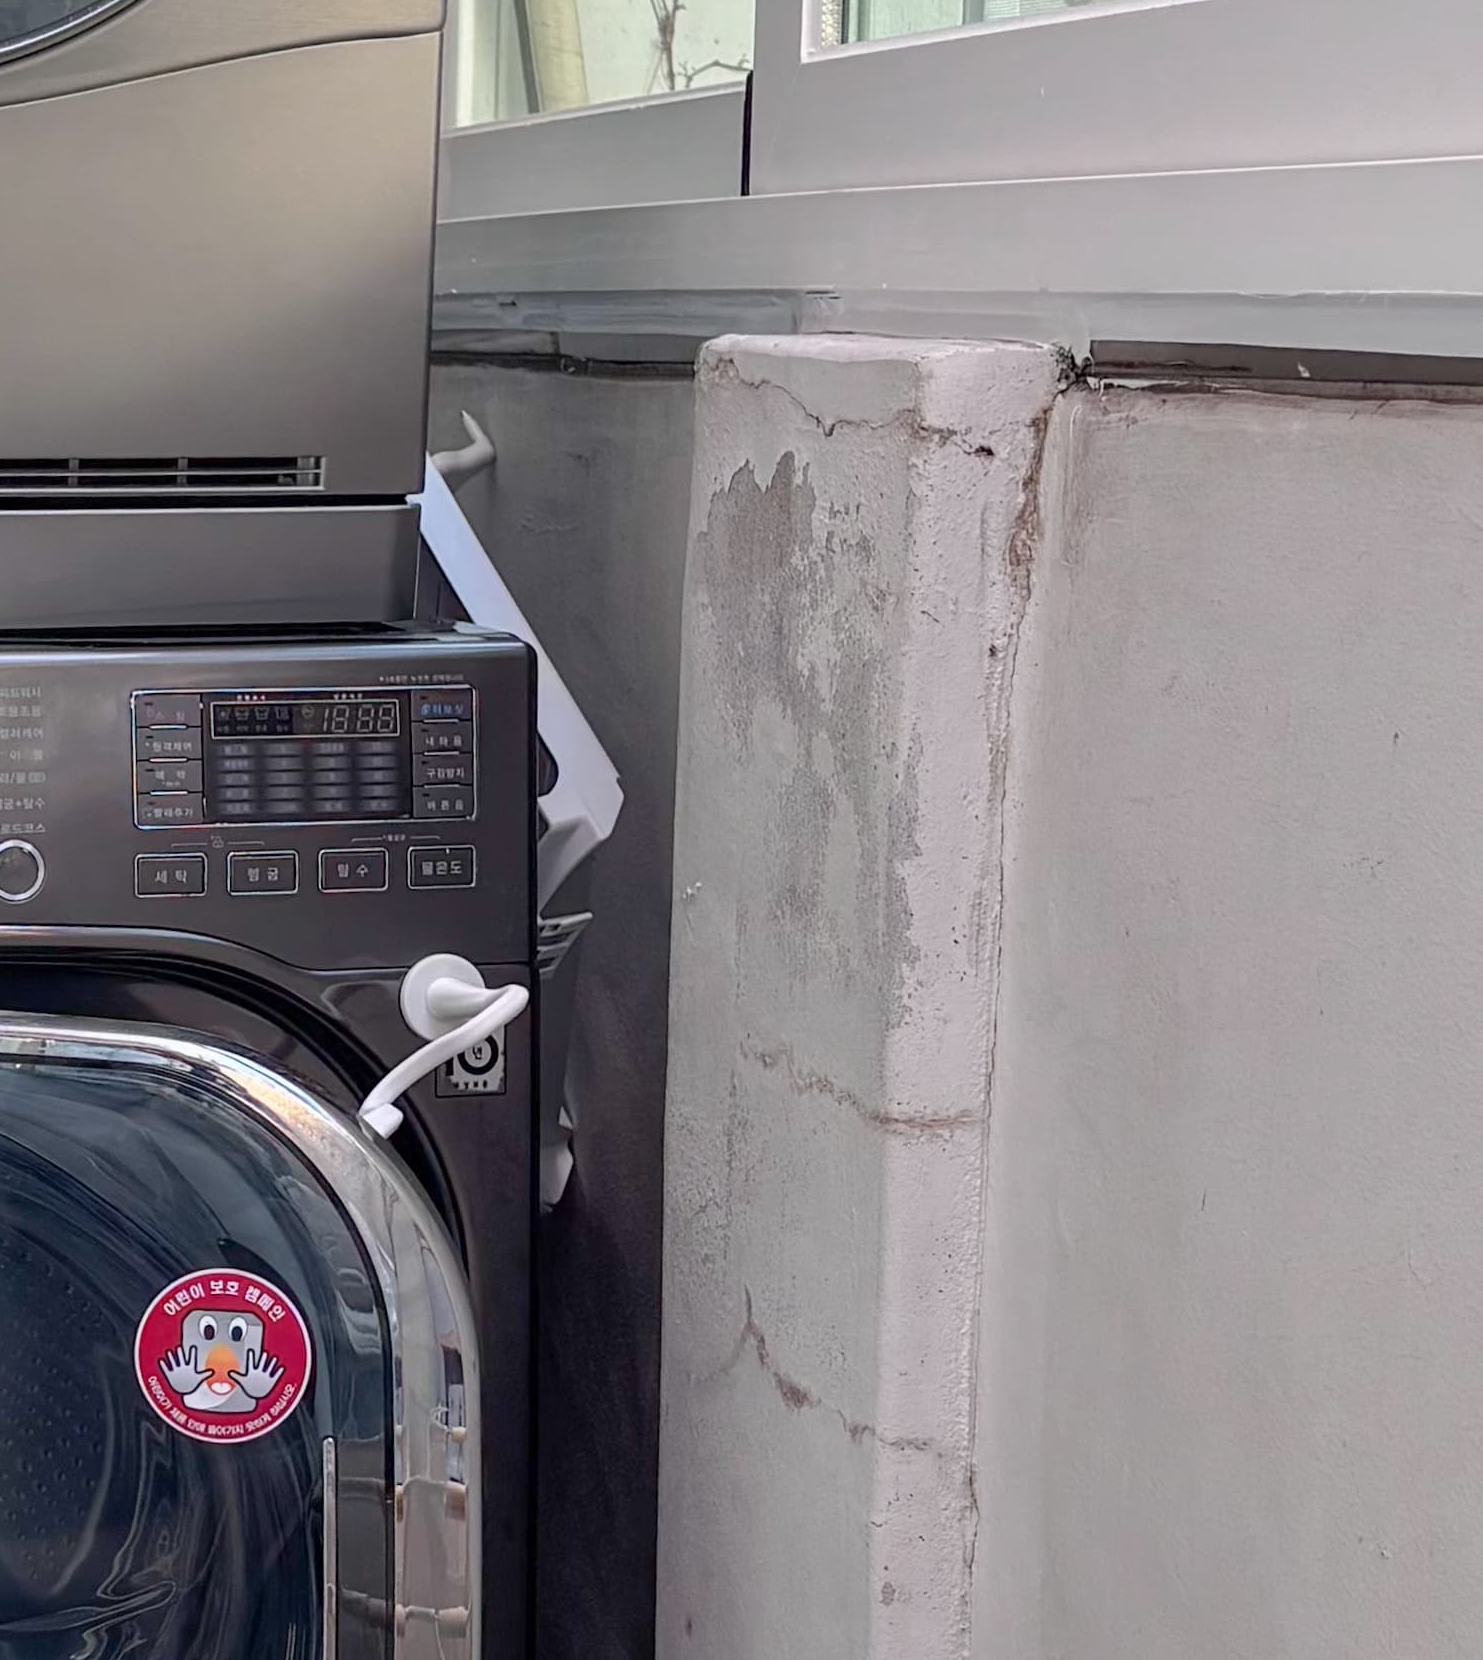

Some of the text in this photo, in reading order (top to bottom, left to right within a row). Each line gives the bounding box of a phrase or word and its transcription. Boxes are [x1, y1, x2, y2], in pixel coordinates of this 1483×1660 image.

[163, 1279, 286, 1322] 어린이 보호 캠페인
